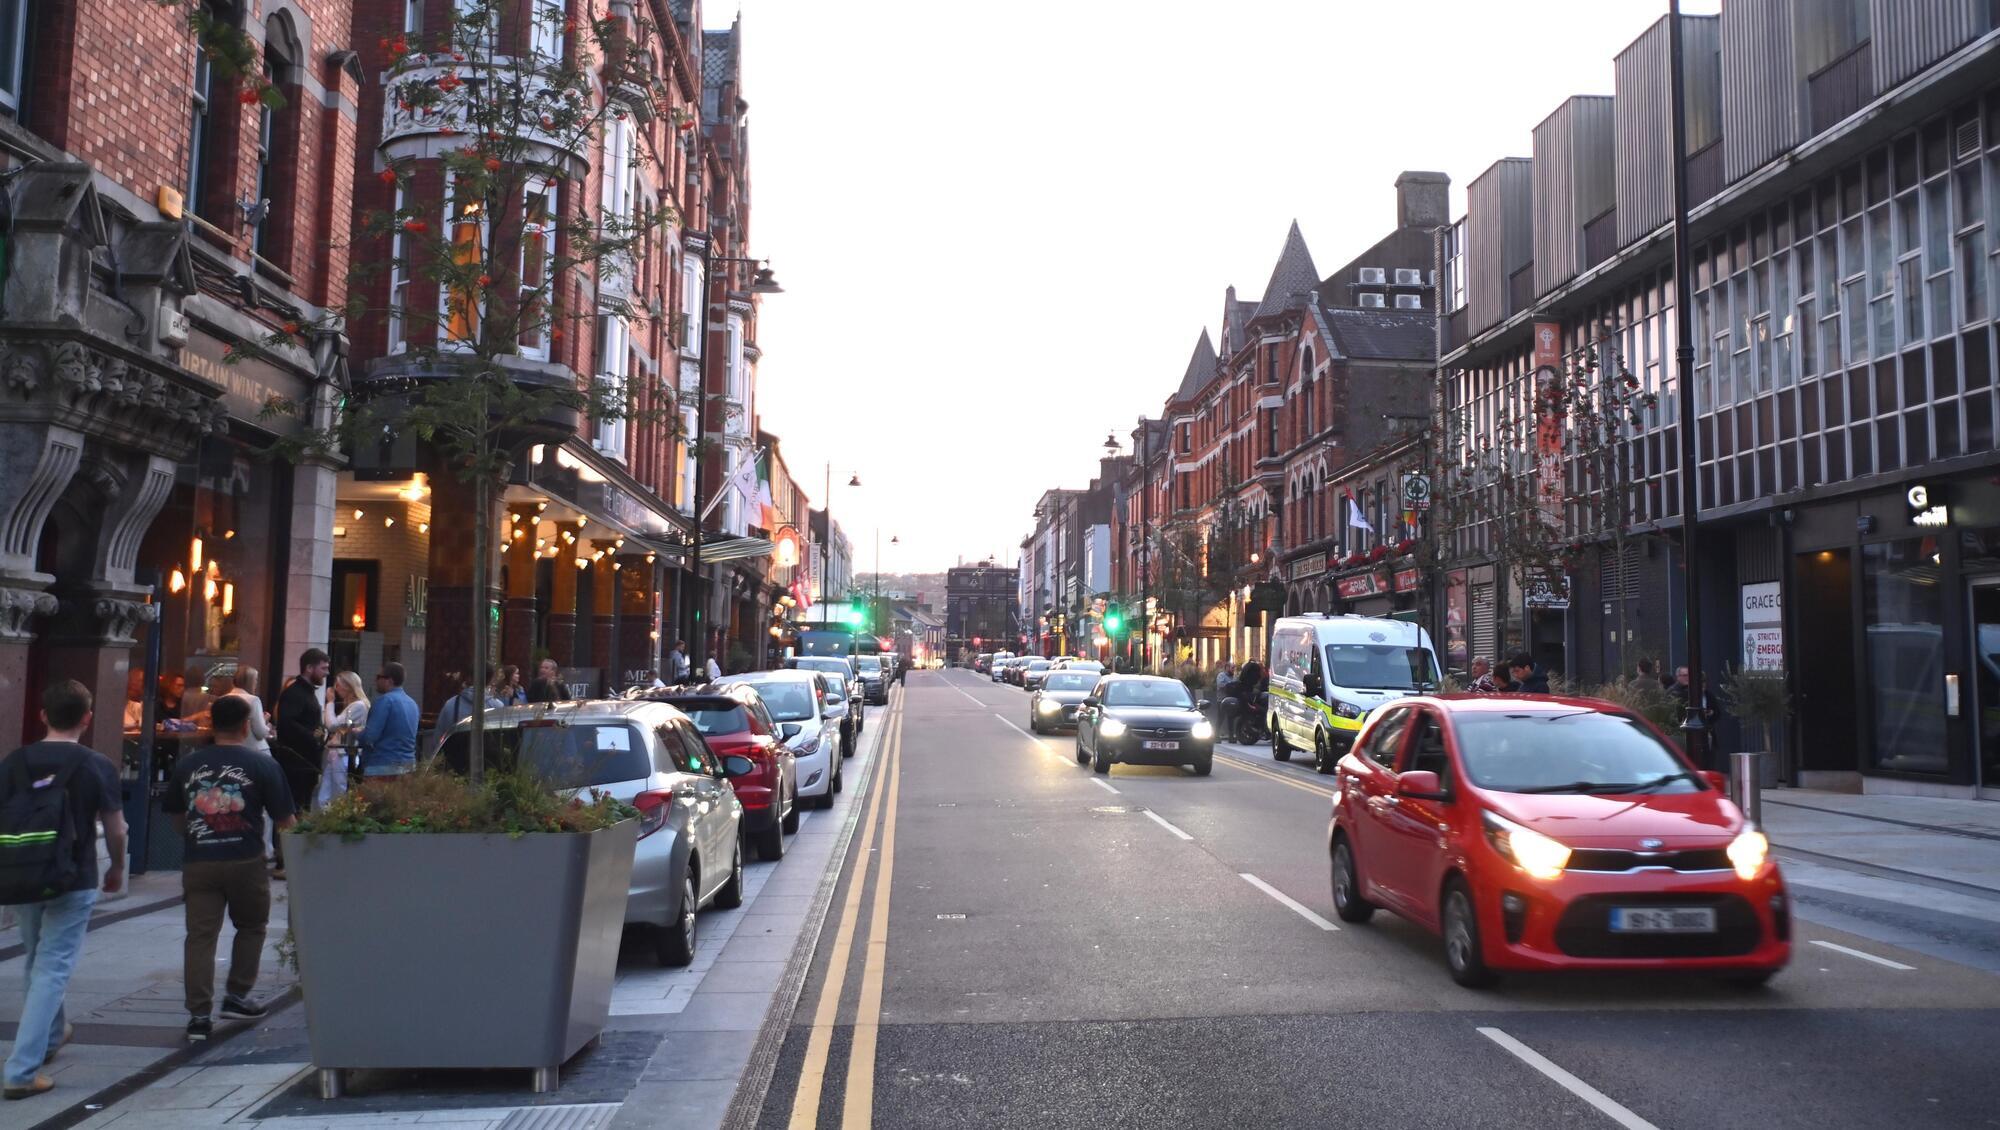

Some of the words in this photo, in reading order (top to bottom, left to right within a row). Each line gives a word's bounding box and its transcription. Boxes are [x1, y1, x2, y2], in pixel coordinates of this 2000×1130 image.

[180, 349, 229, 388] URTAIN
[231, 371, 262, 404] WINE
[1745, 594, 1774, 610] GRACE
[1757, 632, 1780, 641] STRICTLY
[218, 765, 254, 786] Valley
